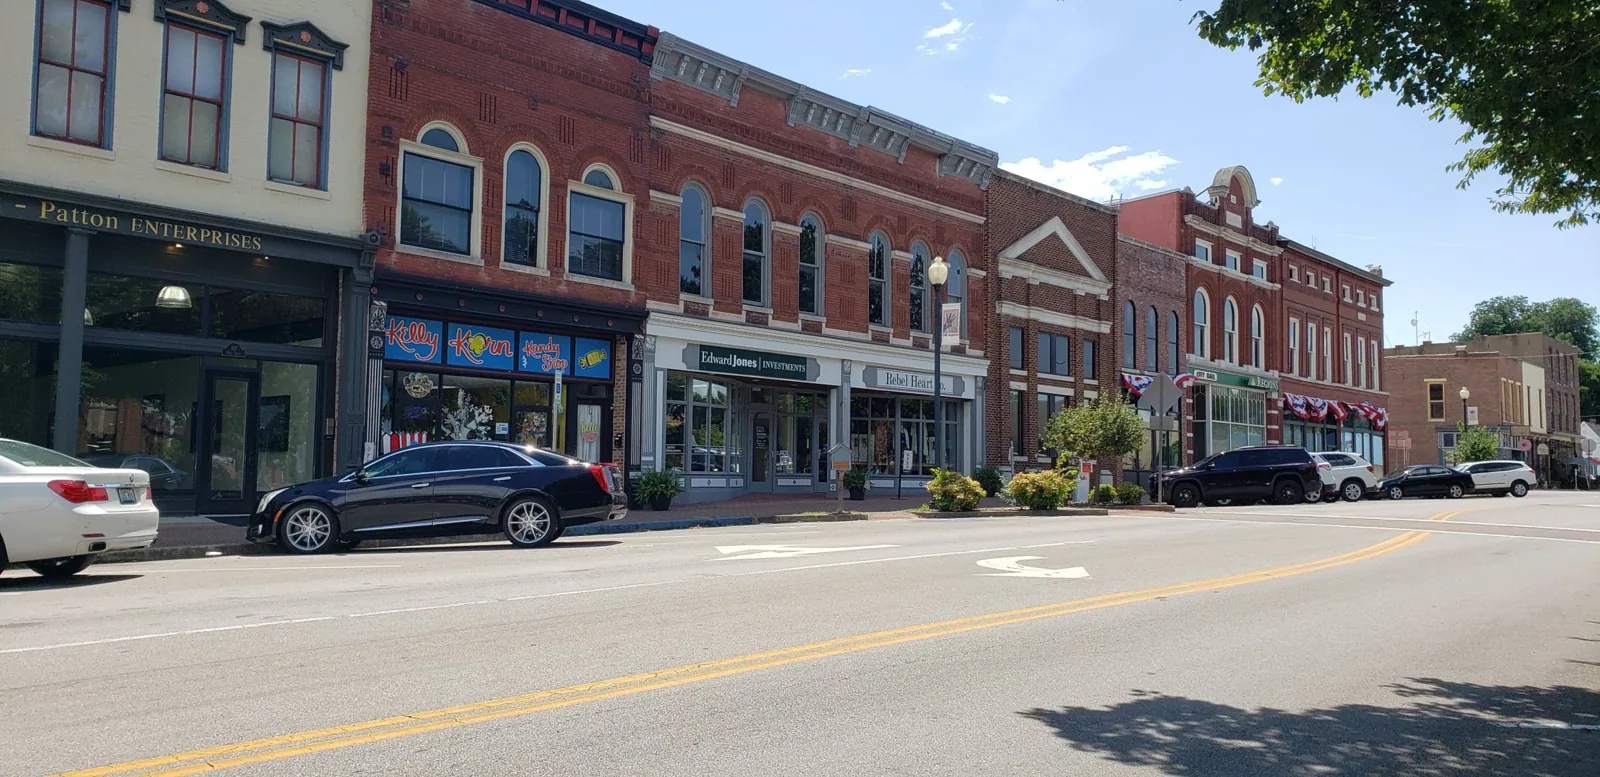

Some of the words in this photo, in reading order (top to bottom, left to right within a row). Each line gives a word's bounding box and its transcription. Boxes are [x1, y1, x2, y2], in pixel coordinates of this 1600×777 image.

[40, 200, 118, 230] Patton
[131, 217, 262, 251] ENTERPRISES
[385, 318, 439, 361] Kelly
[448, 327, 514, 365] Korn
[522, 336, 560, 360] Kandy
[541, 353, 568, 374] Shop
[762, 360, 806, 373] INVESTMENTS
[885, 371, 909, 387] Rebel
[911, 374, 933, 390] Heart
[1257, 377, 1279, 389] REGIONS
